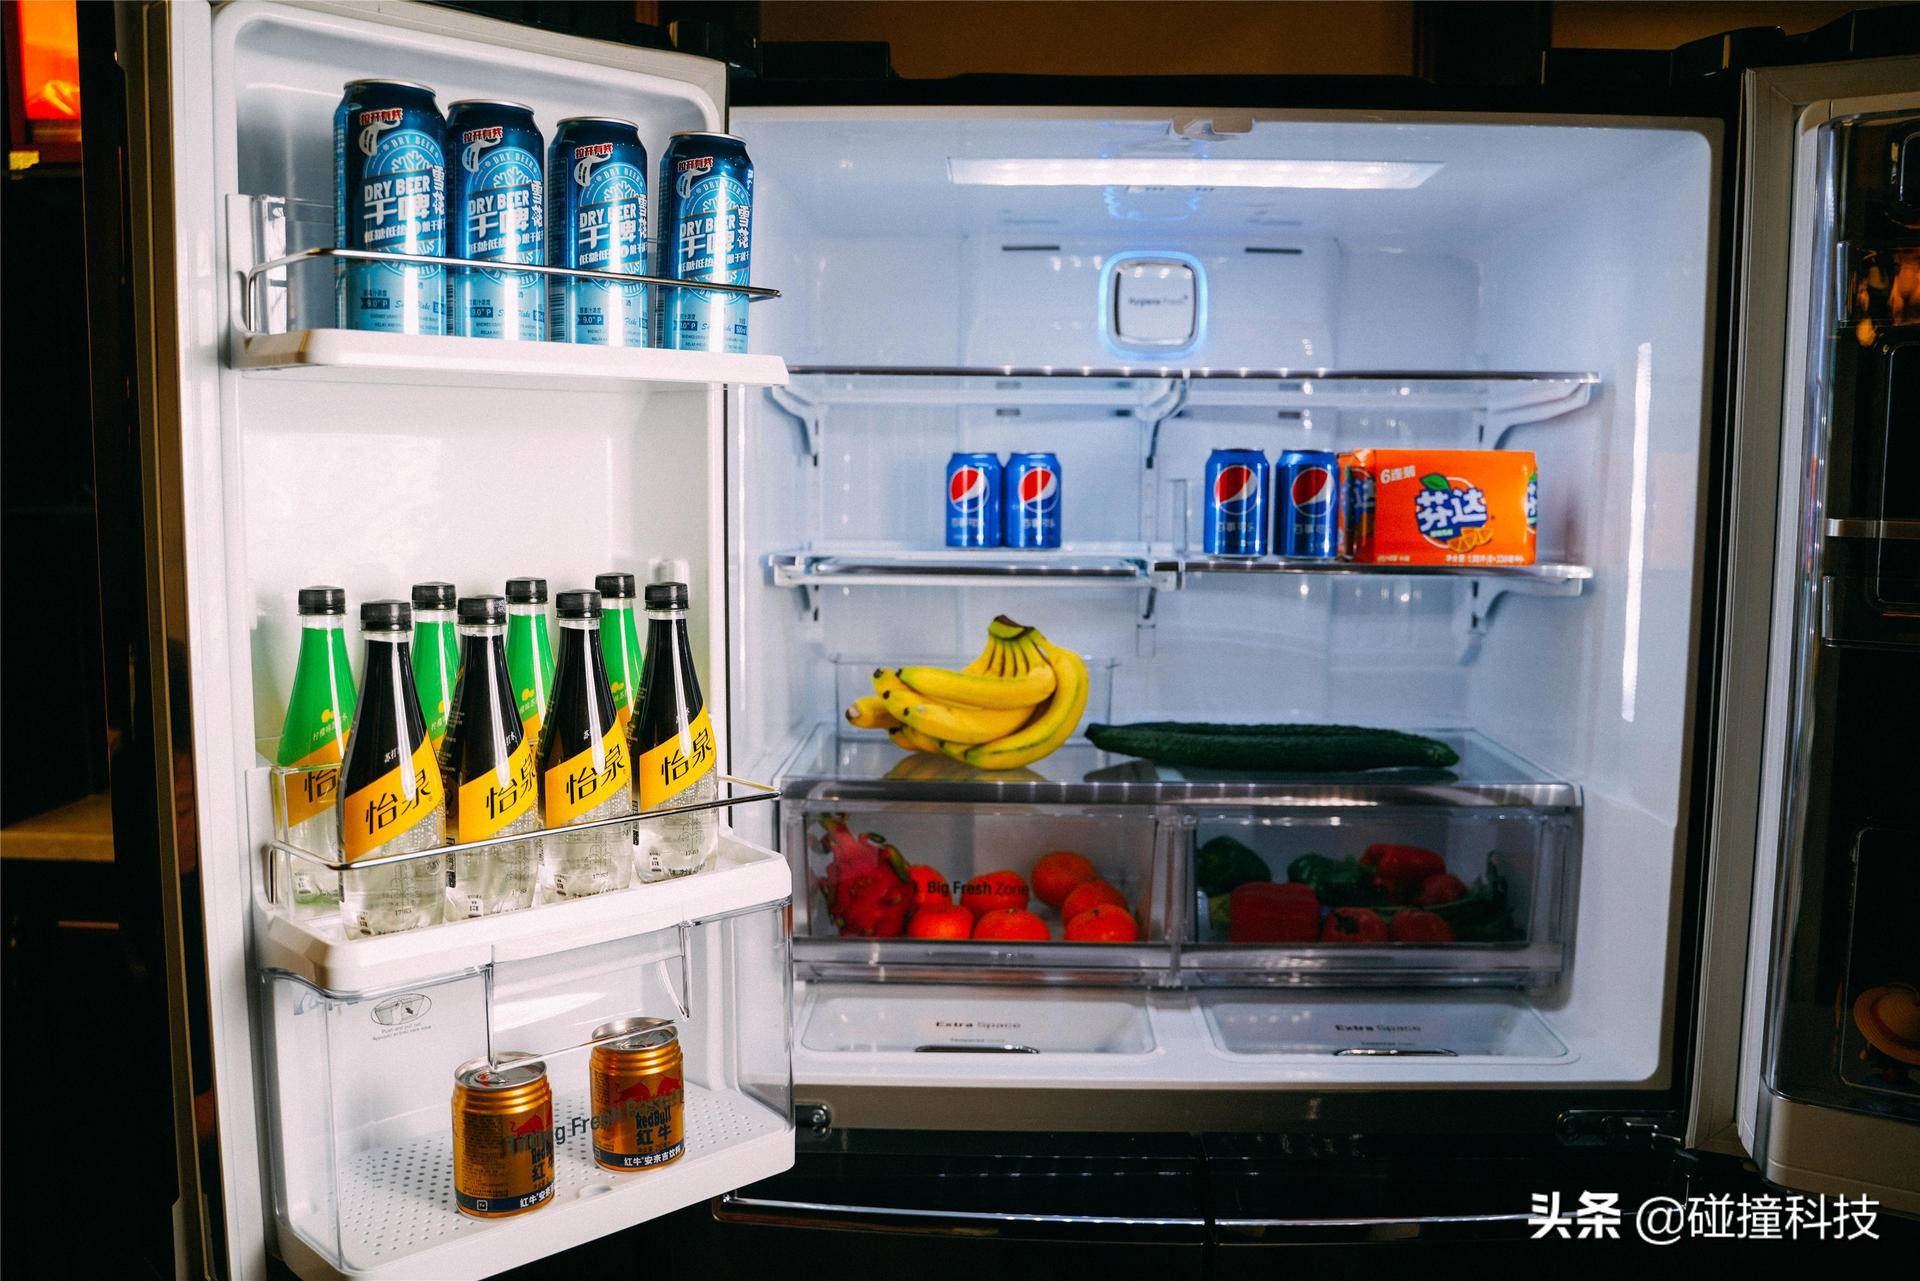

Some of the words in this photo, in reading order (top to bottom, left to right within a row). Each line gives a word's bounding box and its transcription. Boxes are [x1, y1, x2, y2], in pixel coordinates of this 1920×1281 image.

[391, 135, 410, 148] DRY
[414, 134, 436, 154] BEER
[493, 153, 511, 164] DRY
[515, 153, 535, 169] BEER
[364, 180, 393, 202] DRY
[396, 174, 430, 196] BEER
[469, 195, 496, 215] DRY
[497, 189, 529, 210] BEER
[364, 194, 430, 224] 干啤
[470, 206, 529, 239] 干啤
[580, 212, 604, 230] DRY
[580, 221, 635, 249] 干啤
[680, 218, 703, 237] DRY
[680, 232, 734, 258] 干啤
[1416, 489, 1487, 531] 芬达
[661, 728, 713, 788] 怡泉
[304, 768, 337, 803] 怡
[486, 751, 536, 820] 怡泉
[566, 744, 625, 806] 怡泉
[365, 769, 432, 835] 怡泉
[927, 880, 949, 897] Big
[953, 880, 991, 896] Fresh
[993, 882, 1029, 896] Zone
[1335, 1024, 1375, 1032] Extra
[571, 1106, 622, 1137] Fresh
[635, 1105, 672, 1129] RedBull
[636, 1124, 672, 1146] 红牛
